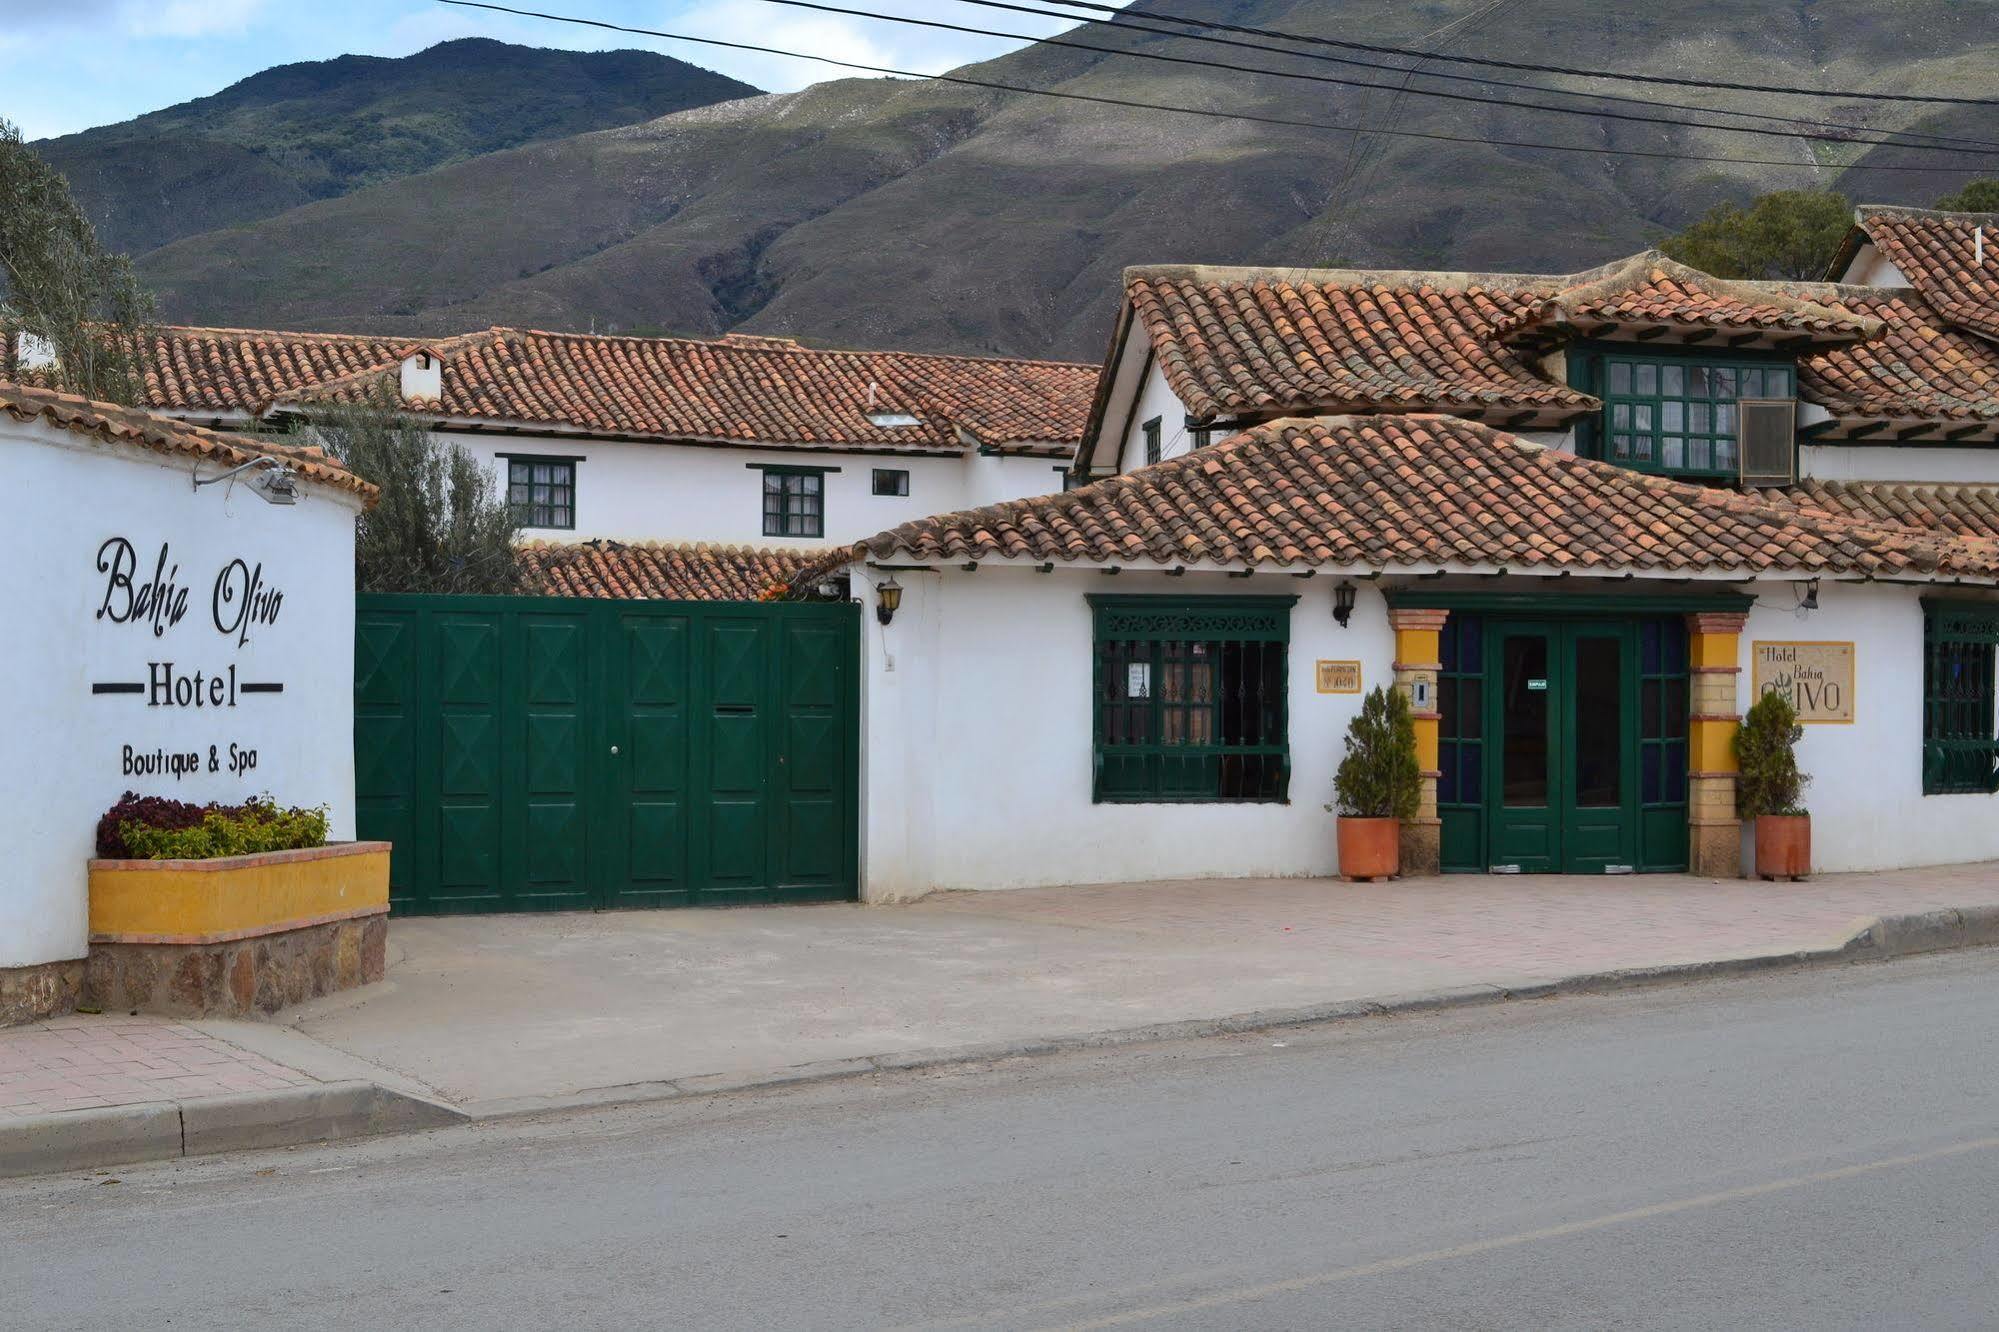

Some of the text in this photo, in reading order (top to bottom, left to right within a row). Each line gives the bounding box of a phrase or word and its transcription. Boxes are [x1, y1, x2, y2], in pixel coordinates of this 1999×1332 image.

[97, 537, 284, 649] Bahía Olivo
[1766, 647, 1797, 662] Hotel
[147, 662, 237, 708] Hotel
[122, 742, 258, 781] Boutique & Spa
